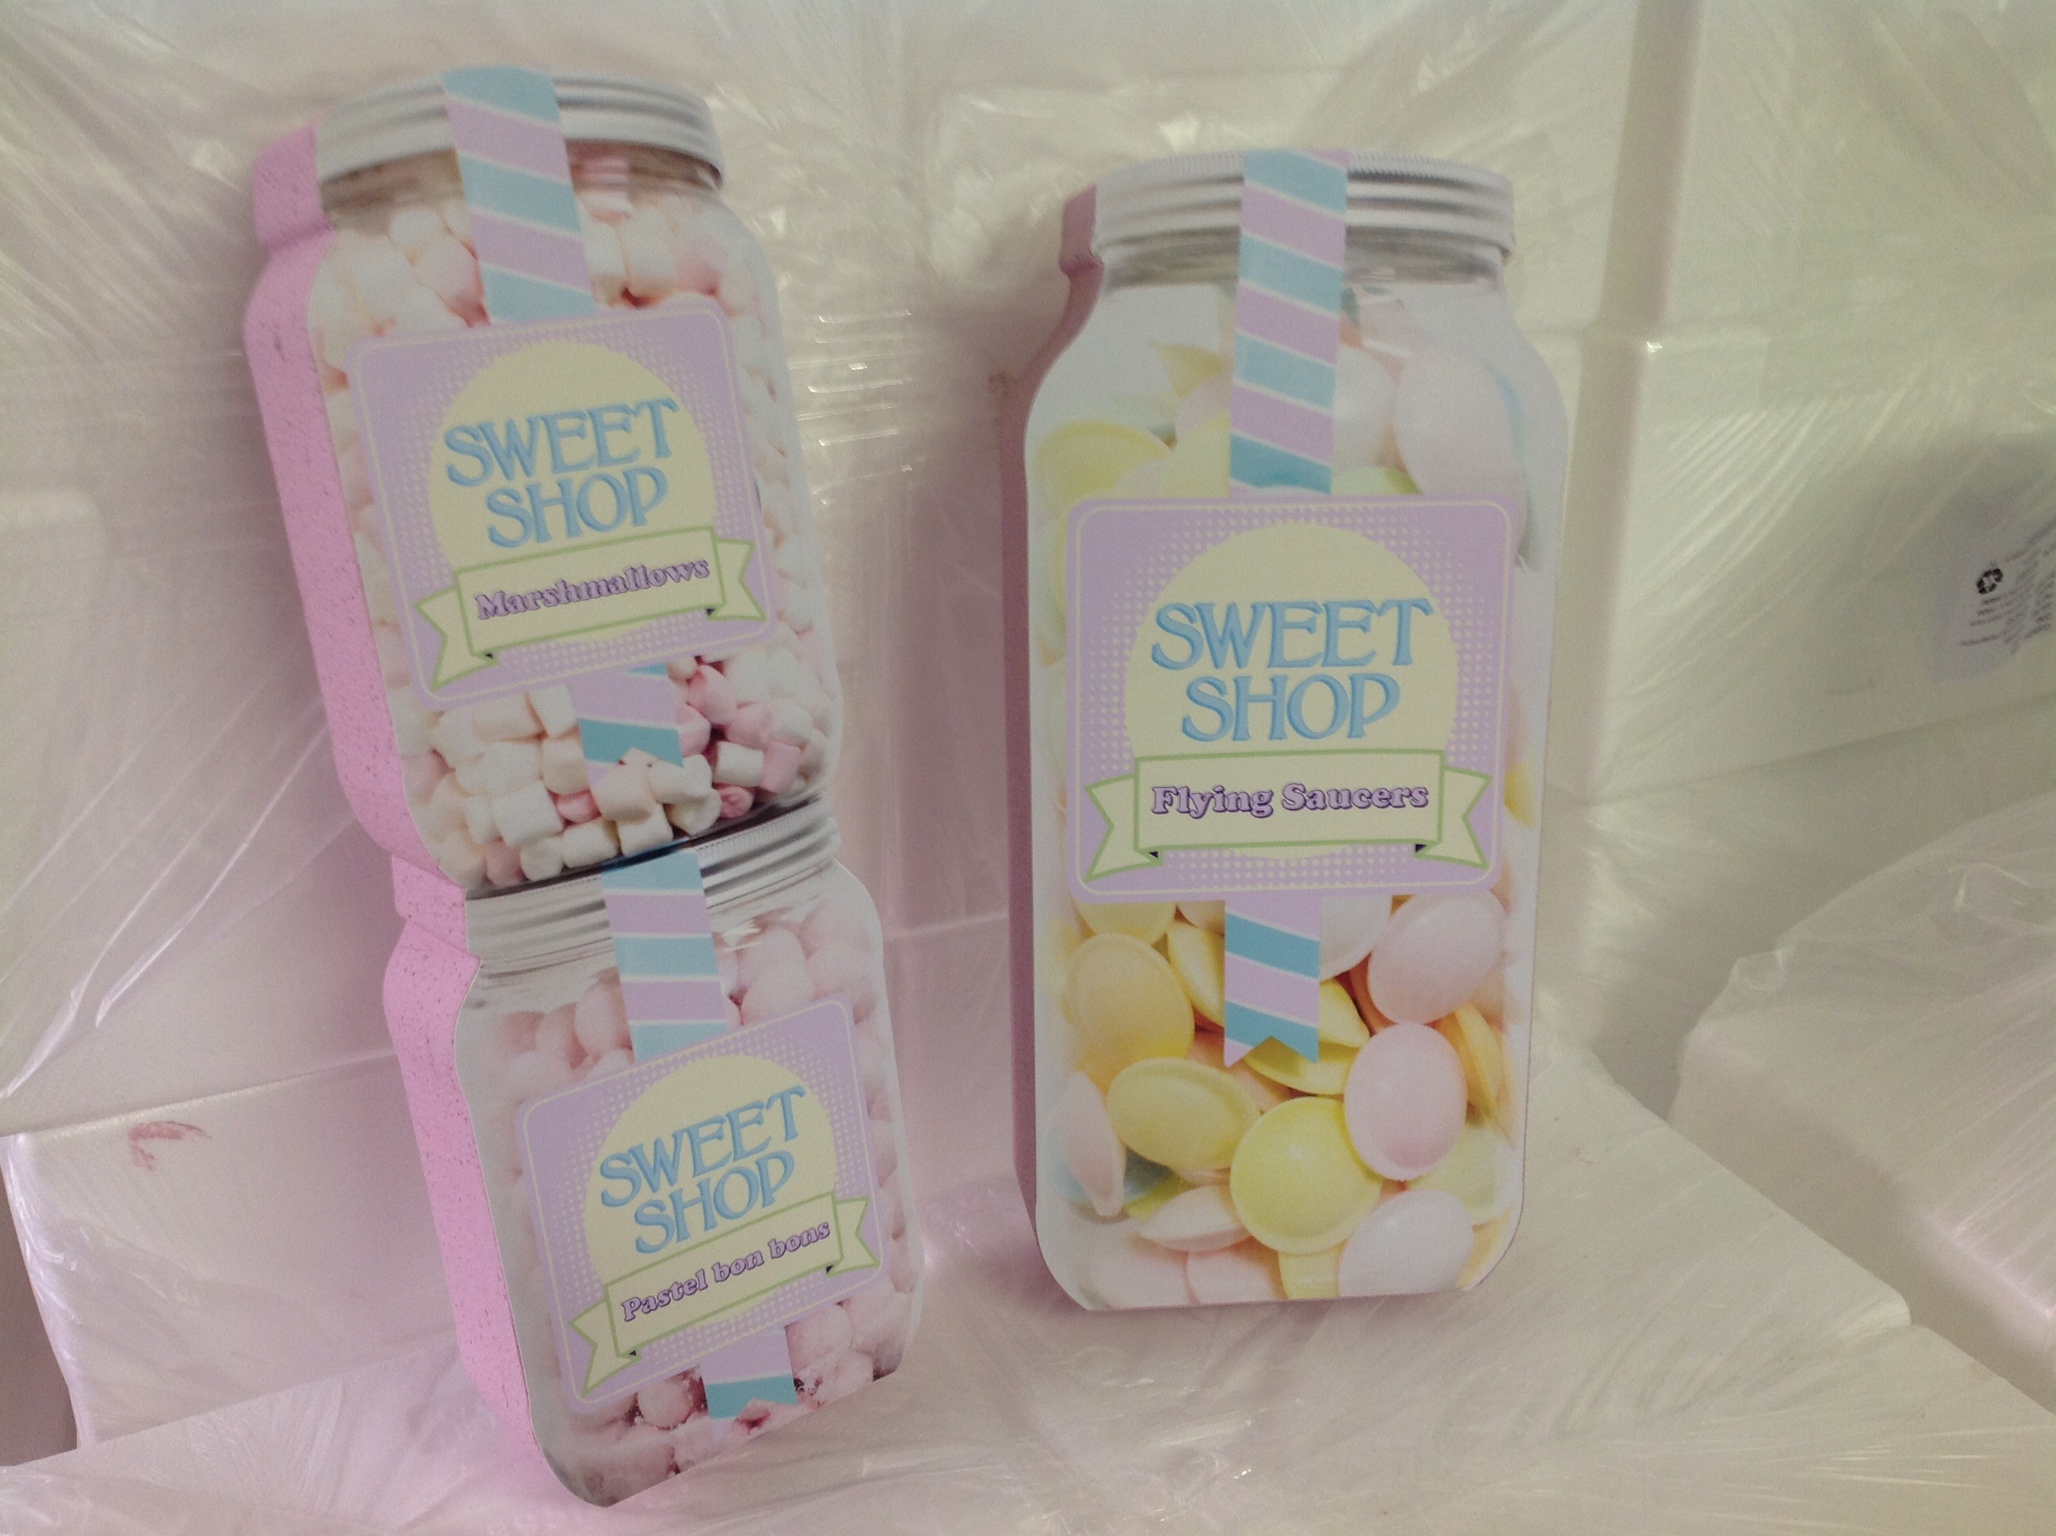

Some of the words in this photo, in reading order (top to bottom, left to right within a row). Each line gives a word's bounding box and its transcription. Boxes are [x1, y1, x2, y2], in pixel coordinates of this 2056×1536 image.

[444, 397, 679, 487] SWEET
[486, 466, 669, 548] SHOP
[475, 559, 710, 620] Marshmallows
[1151, 598, 1434, 671] SWEET
[1182, 673, 1400, 742] SHOP
[1151, 785, 1274, 819] Flying
[1281, 783, 1429, 812] Saucers
[600, 1085, 806, 1208] SWEET
[634, 1150, 794, 1254] SHOP
[621, 1269, 708, 1322] Pastel
[712, 1251, 764, 1283] bon
[768, 1221, 831, 1259] bons
